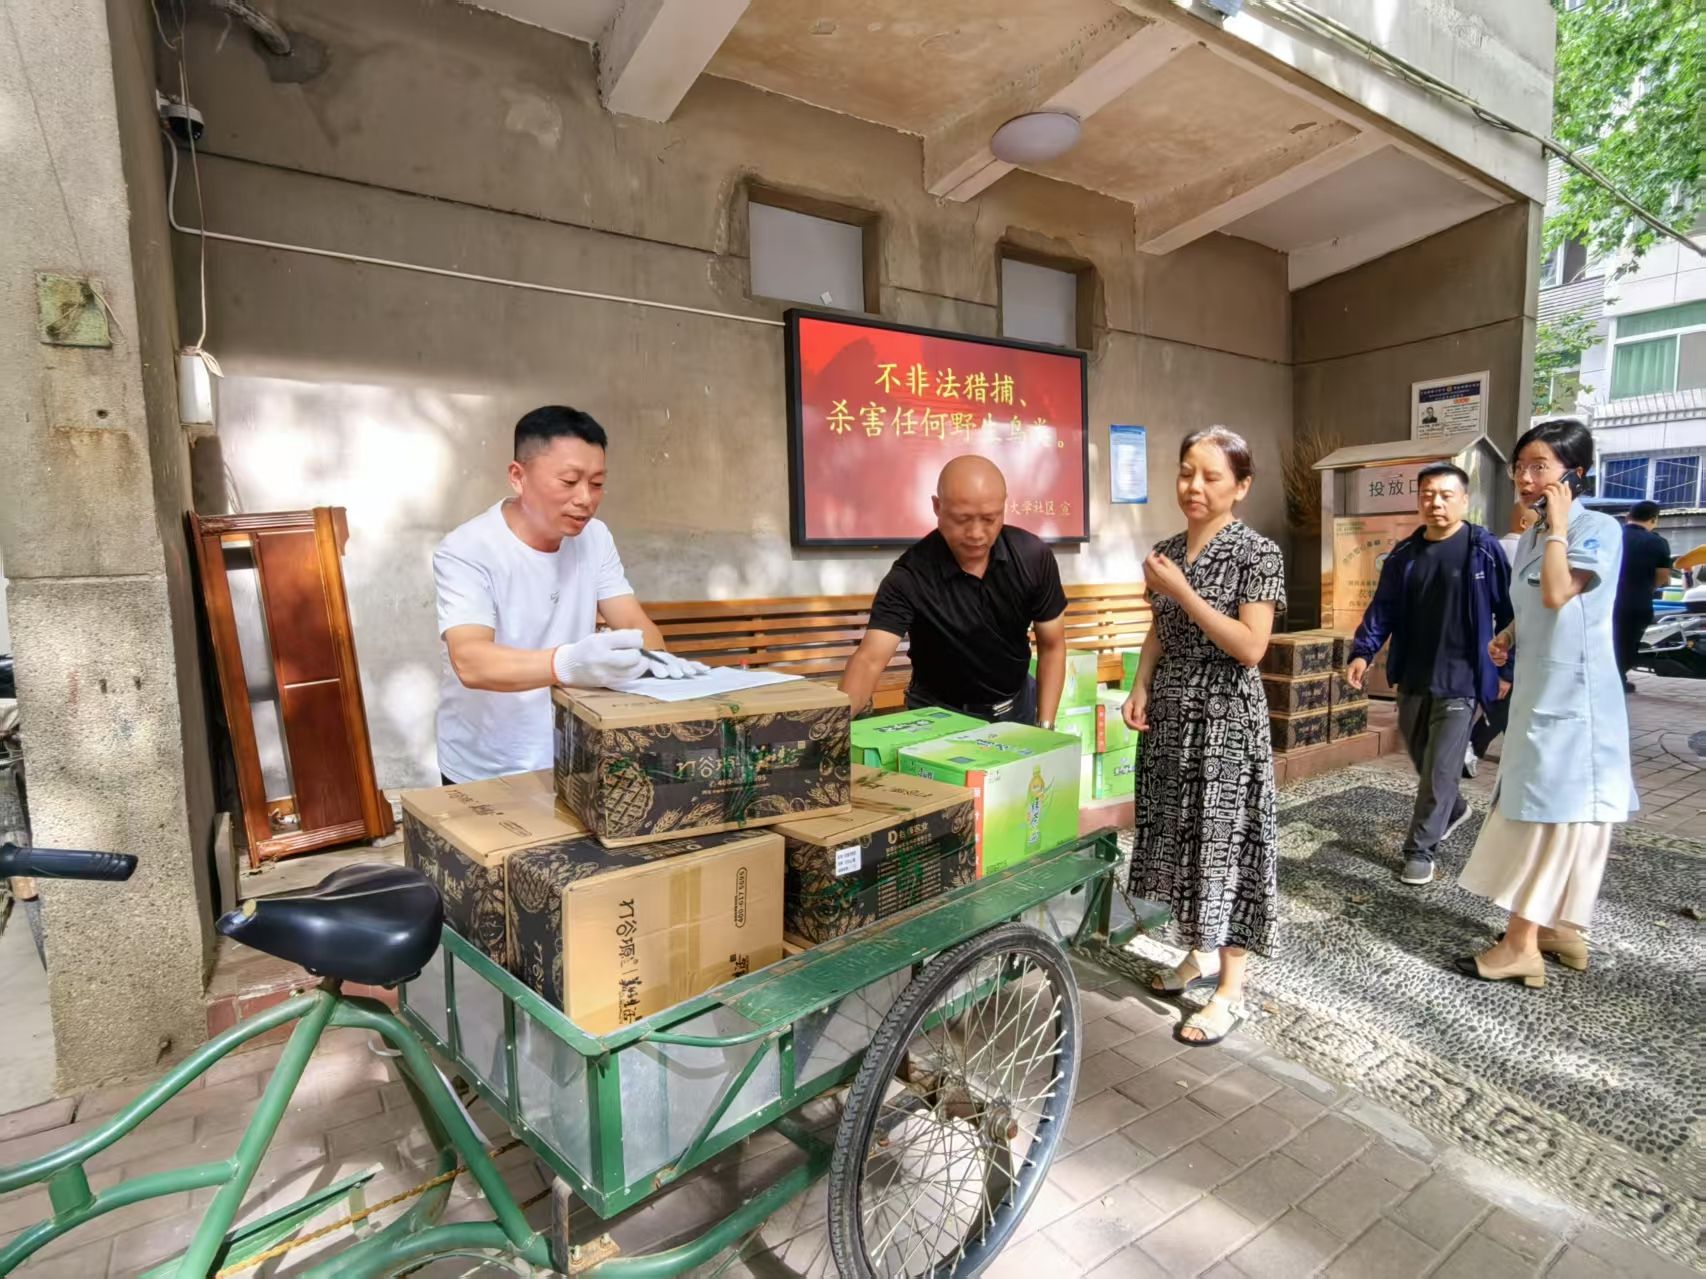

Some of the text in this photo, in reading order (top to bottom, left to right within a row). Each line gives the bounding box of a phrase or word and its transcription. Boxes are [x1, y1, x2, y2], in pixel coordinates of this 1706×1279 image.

[874, 362, 1027, 408] 不非法猎捕、
[1005, 500, 1057, 516] 大学社区
